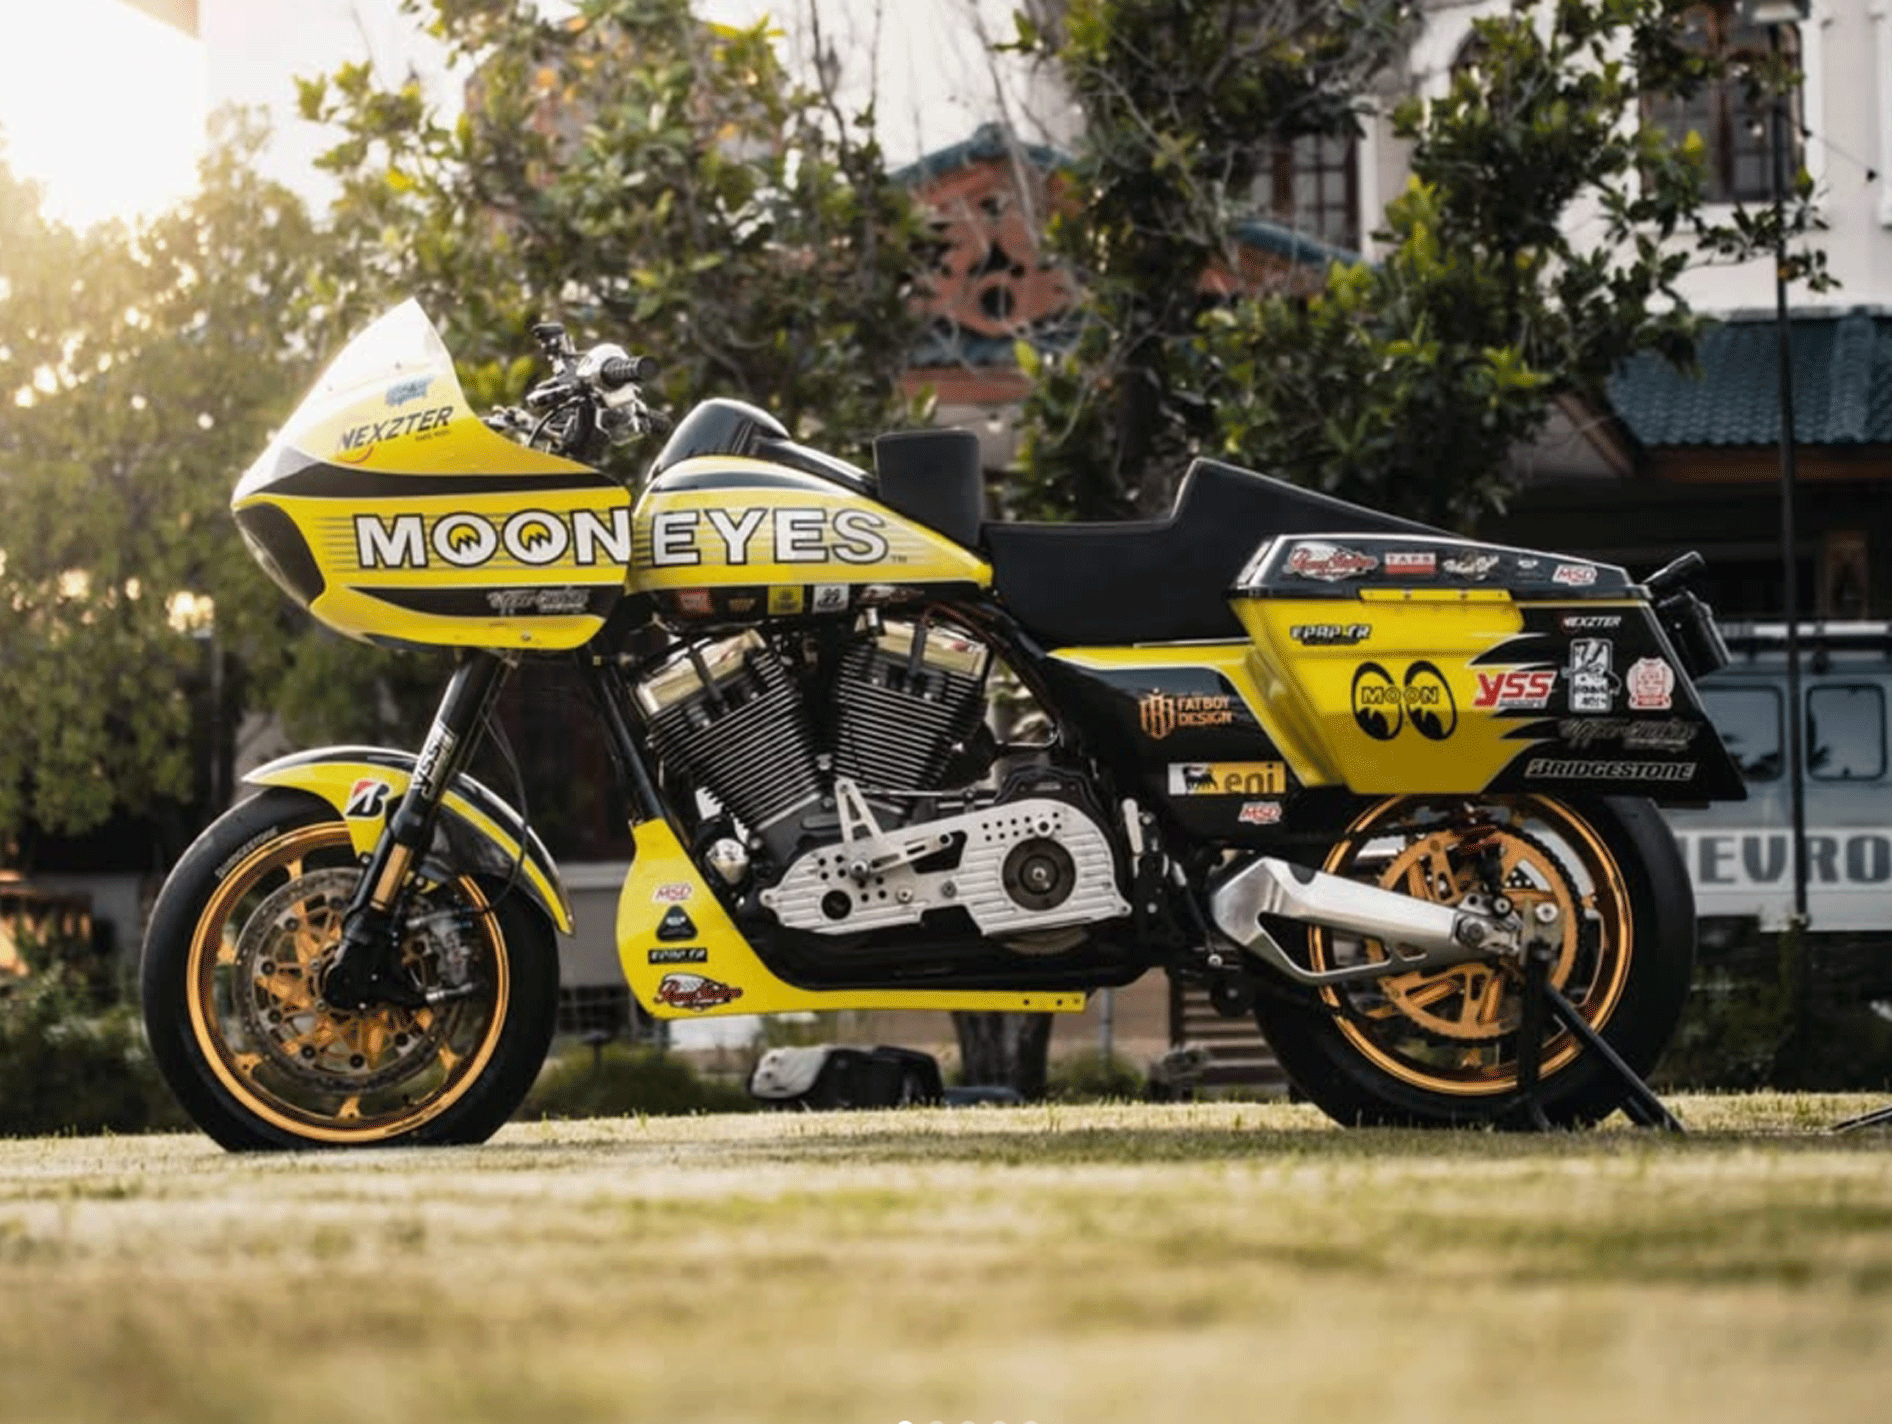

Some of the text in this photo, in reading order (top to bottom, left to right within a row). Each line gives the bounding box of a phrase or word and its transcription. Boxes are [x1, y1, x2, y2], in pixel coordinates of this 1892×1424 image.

[342, 405, 454, 450] NEXZTER
[1176, 695, 1230, 711] FATBOY
[1361, 685, 1439, 704] MOON
[1177, 711, 1233, 727] DESIGN
[1224, 763, 1275, 793] eni
[1525, 758, 1696, 781] BRIDGESTONE
